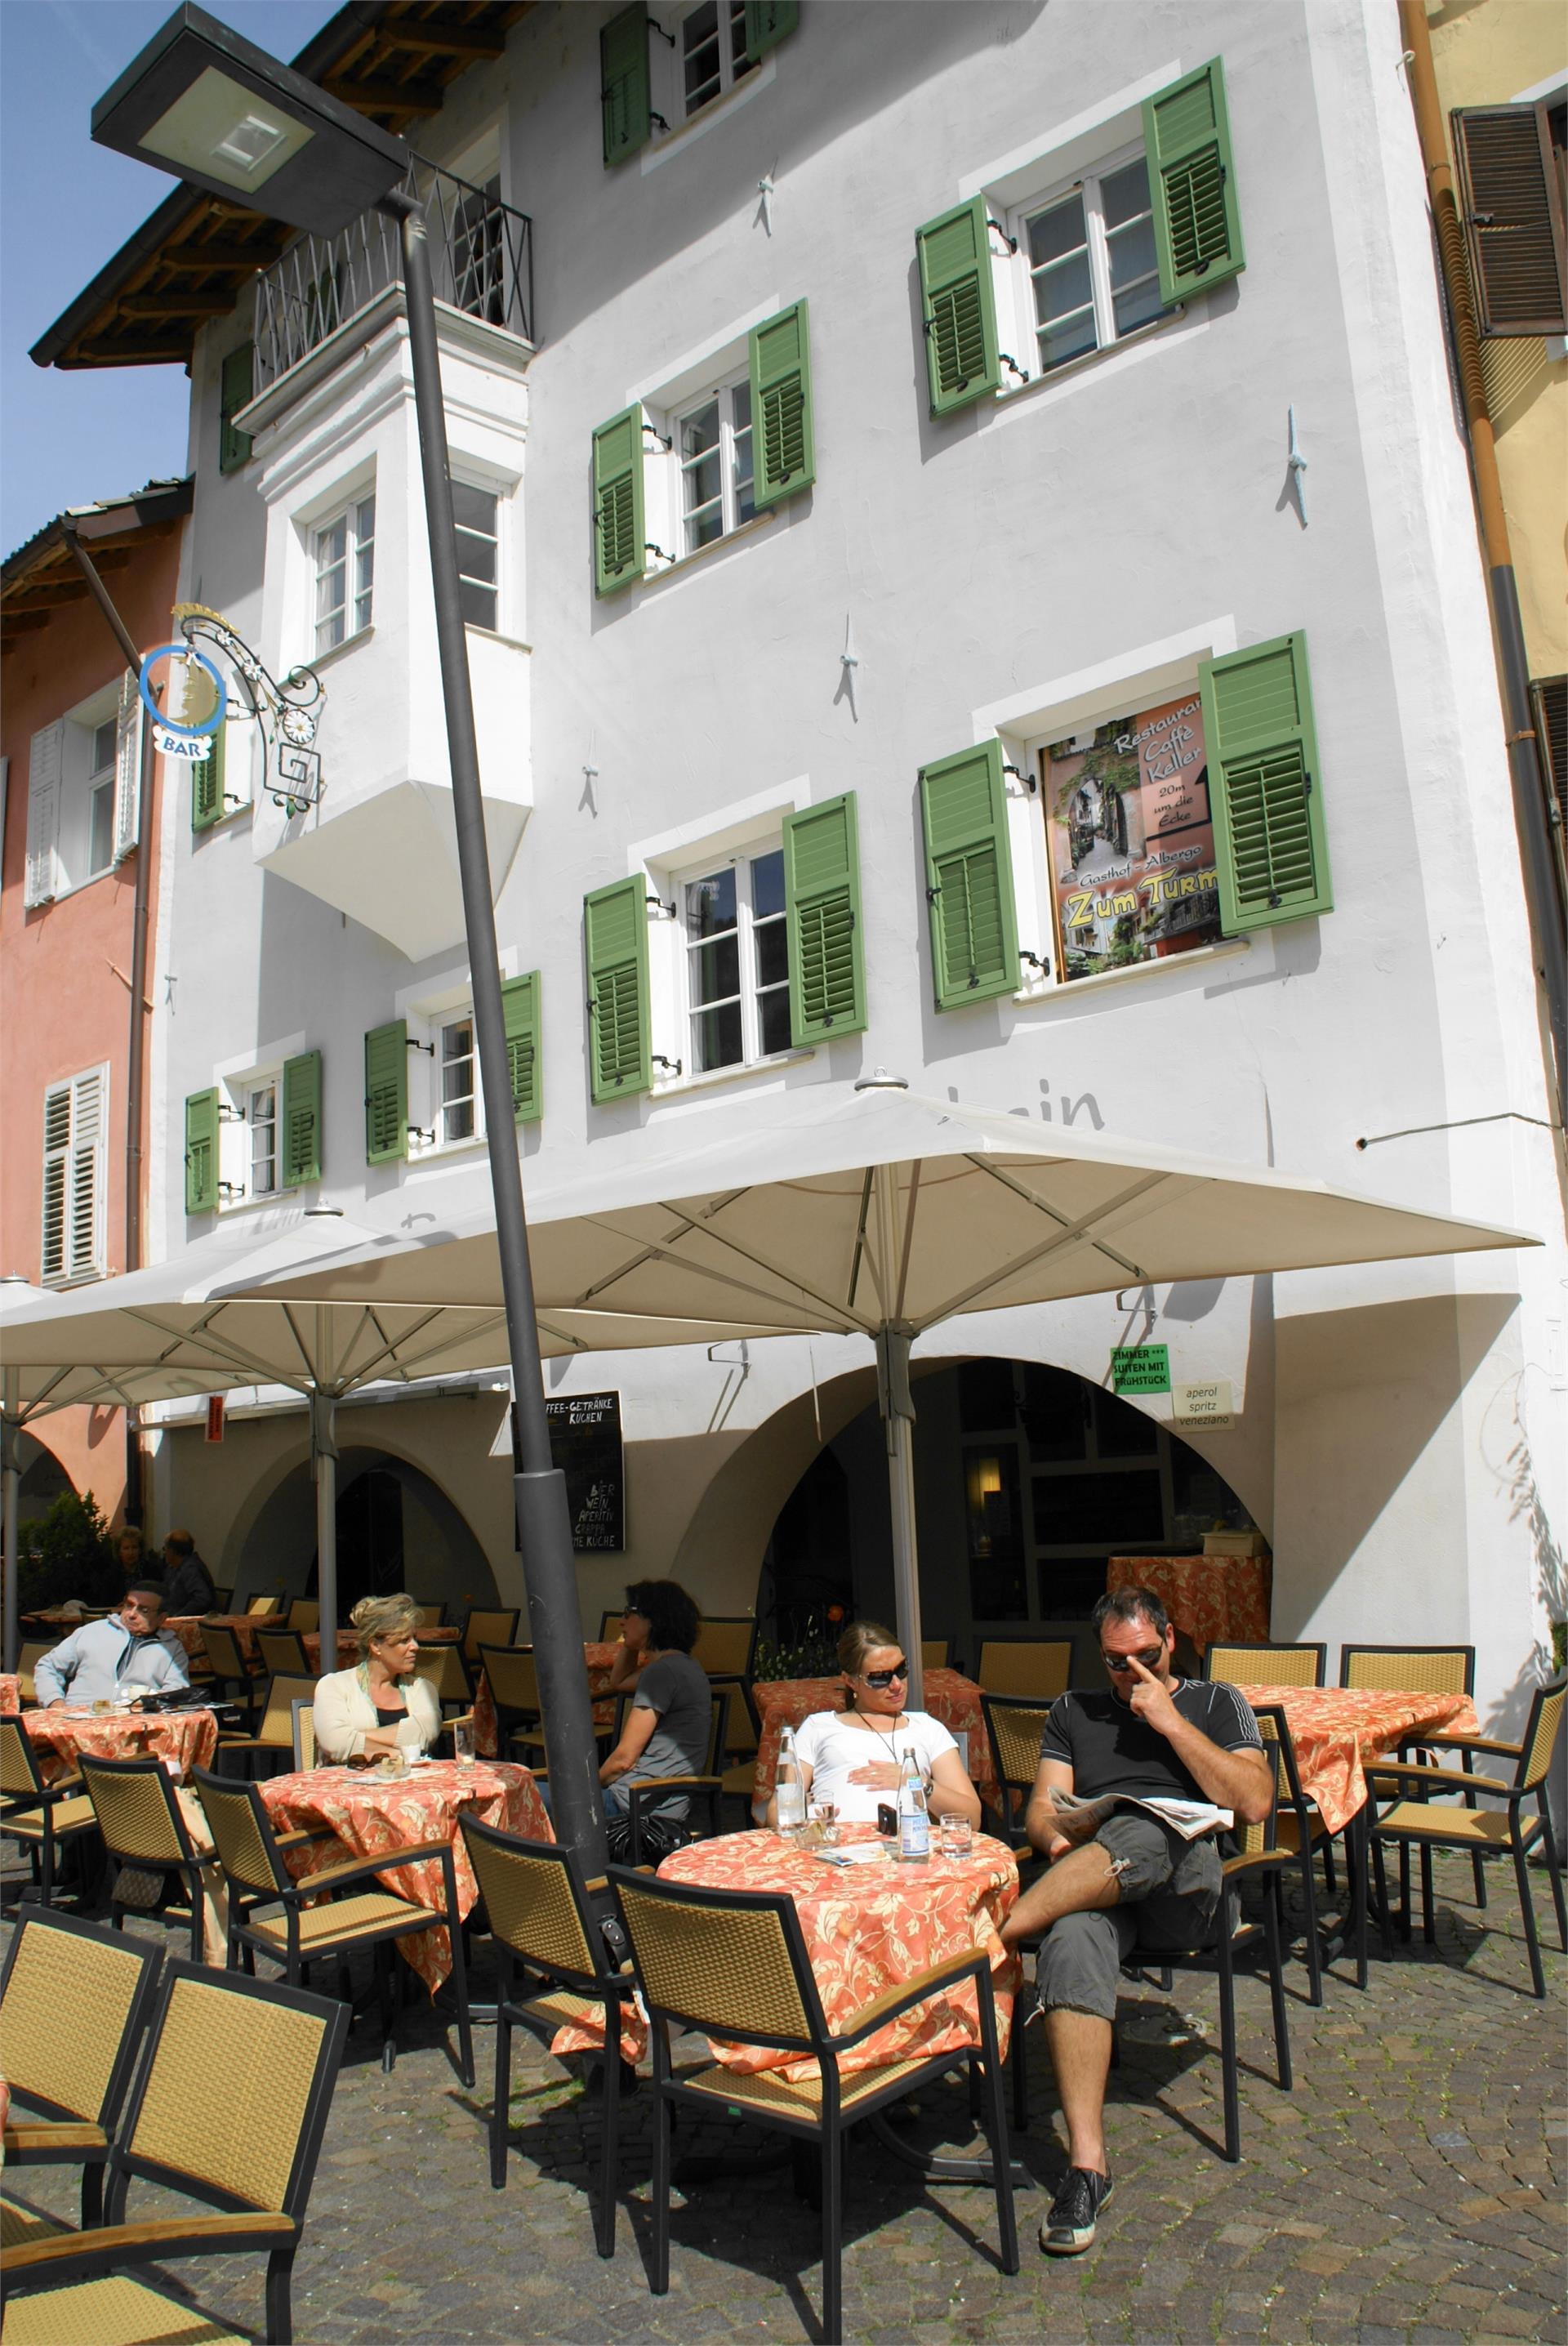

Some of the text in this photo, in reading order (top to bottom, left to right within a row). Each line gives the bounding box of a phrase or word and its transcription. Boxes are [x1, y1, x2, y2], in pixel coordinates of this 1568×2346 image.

[163, 737, 202, 756] BAR
[1144, 725, 1195, 762] Caffè
[1148, 747, 1202, 783] Keller
[1159, 783, 1186, 798] 20m
[1153, 796, 1194, 816] um die
[1159, 811, 1192, 827] Ecke
[1080, 861, 1134, 887] Gasthof
[1145, 846, 1202, 870] Albergo
[1067, 891, 1137, 929] Zum
[1113, 1349, 1150, 1360] ZIMMER
[1114, 1363, 1165, 1373] SUITEN MIT
[1187, 1387, 1217, 1398] aperol
[546, 1397, 612, 1414] FFEE-GETRÄNKE
[1189, 1402, 1217, 1412] spritz
[569, 1412, 602, 1424] KUCHEN
[1180, 1416, 1229, 1425] veneziano
